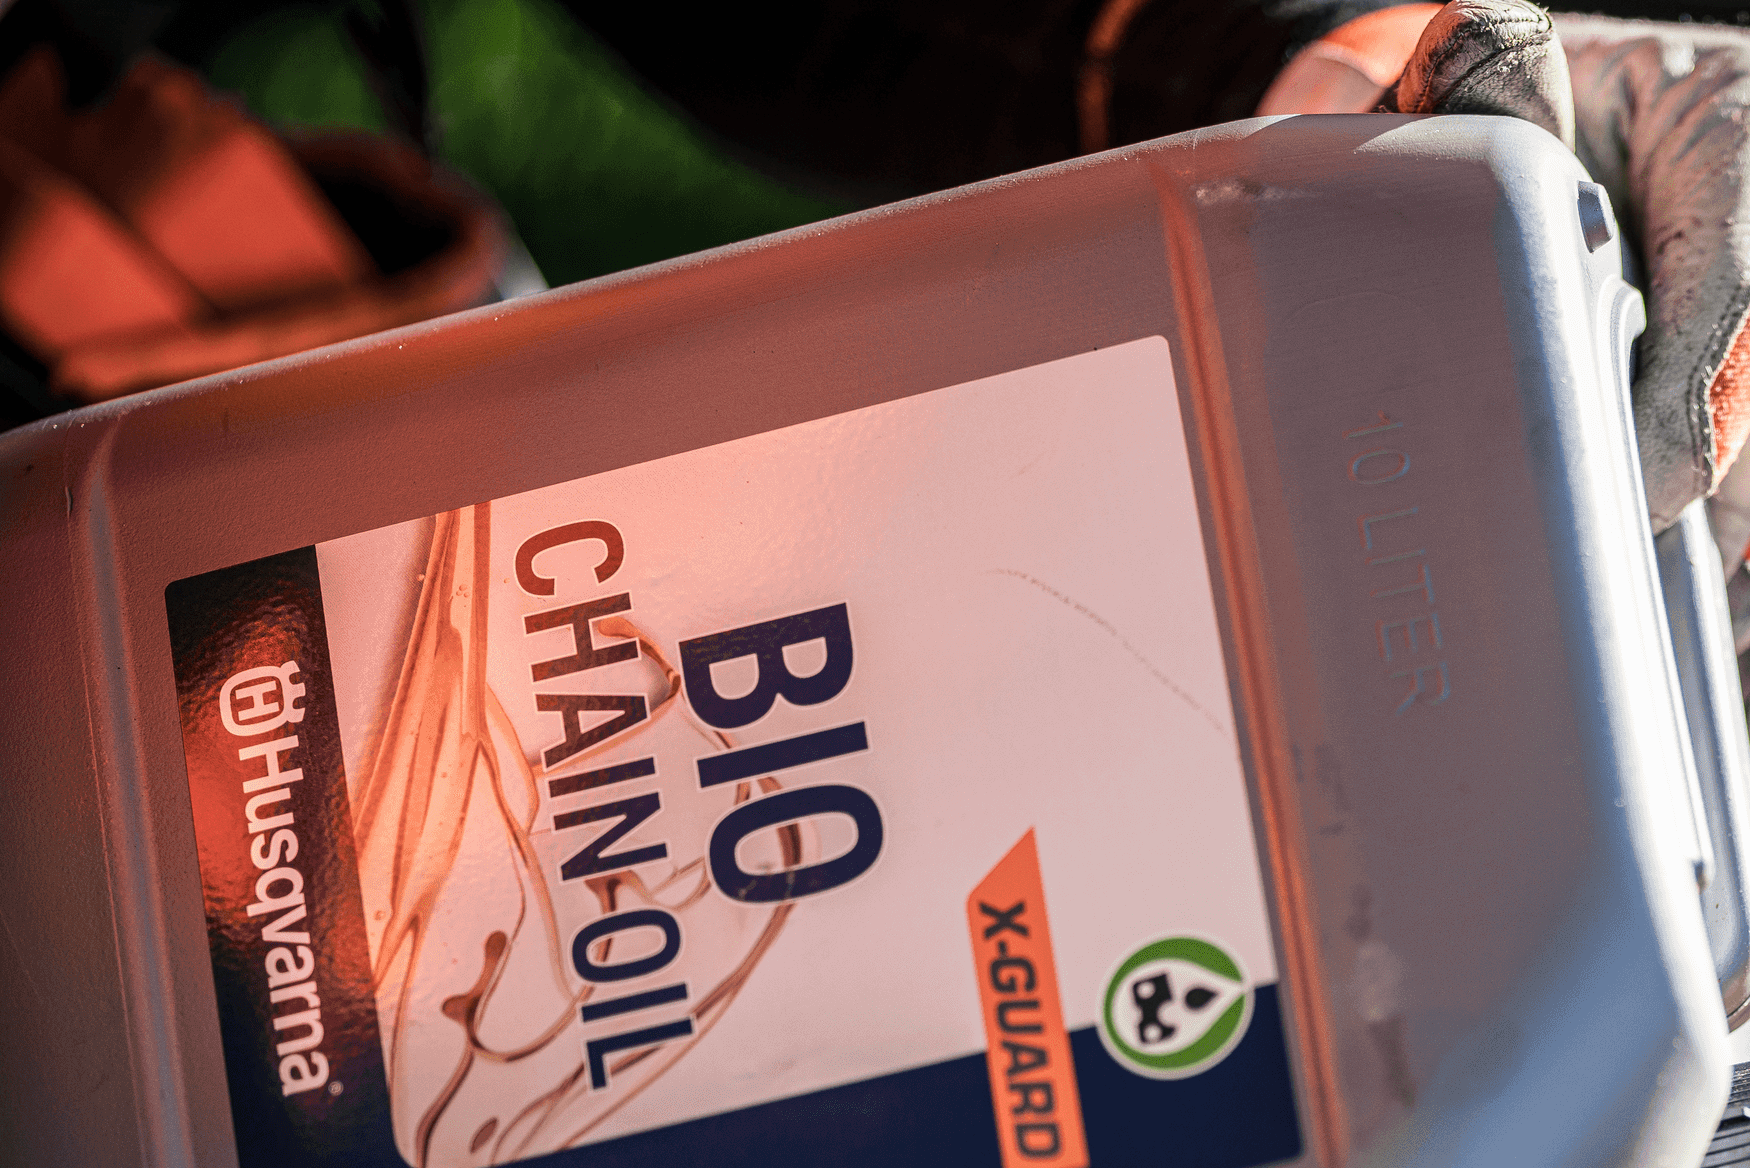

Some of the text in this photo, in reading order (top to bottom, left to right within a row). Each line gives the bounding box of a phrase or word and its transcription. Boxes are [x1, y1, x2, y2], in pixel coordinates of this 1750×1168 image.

[1342, 409, 1451, 716] 10 LITER
[514, 519, 694, 1091] CHAIN OIL
[678, 602, 884, 903] BIO
[238, 734, 331, 1097] Husqvarna
[978, 899, 1062, 1160] X-GUARD
